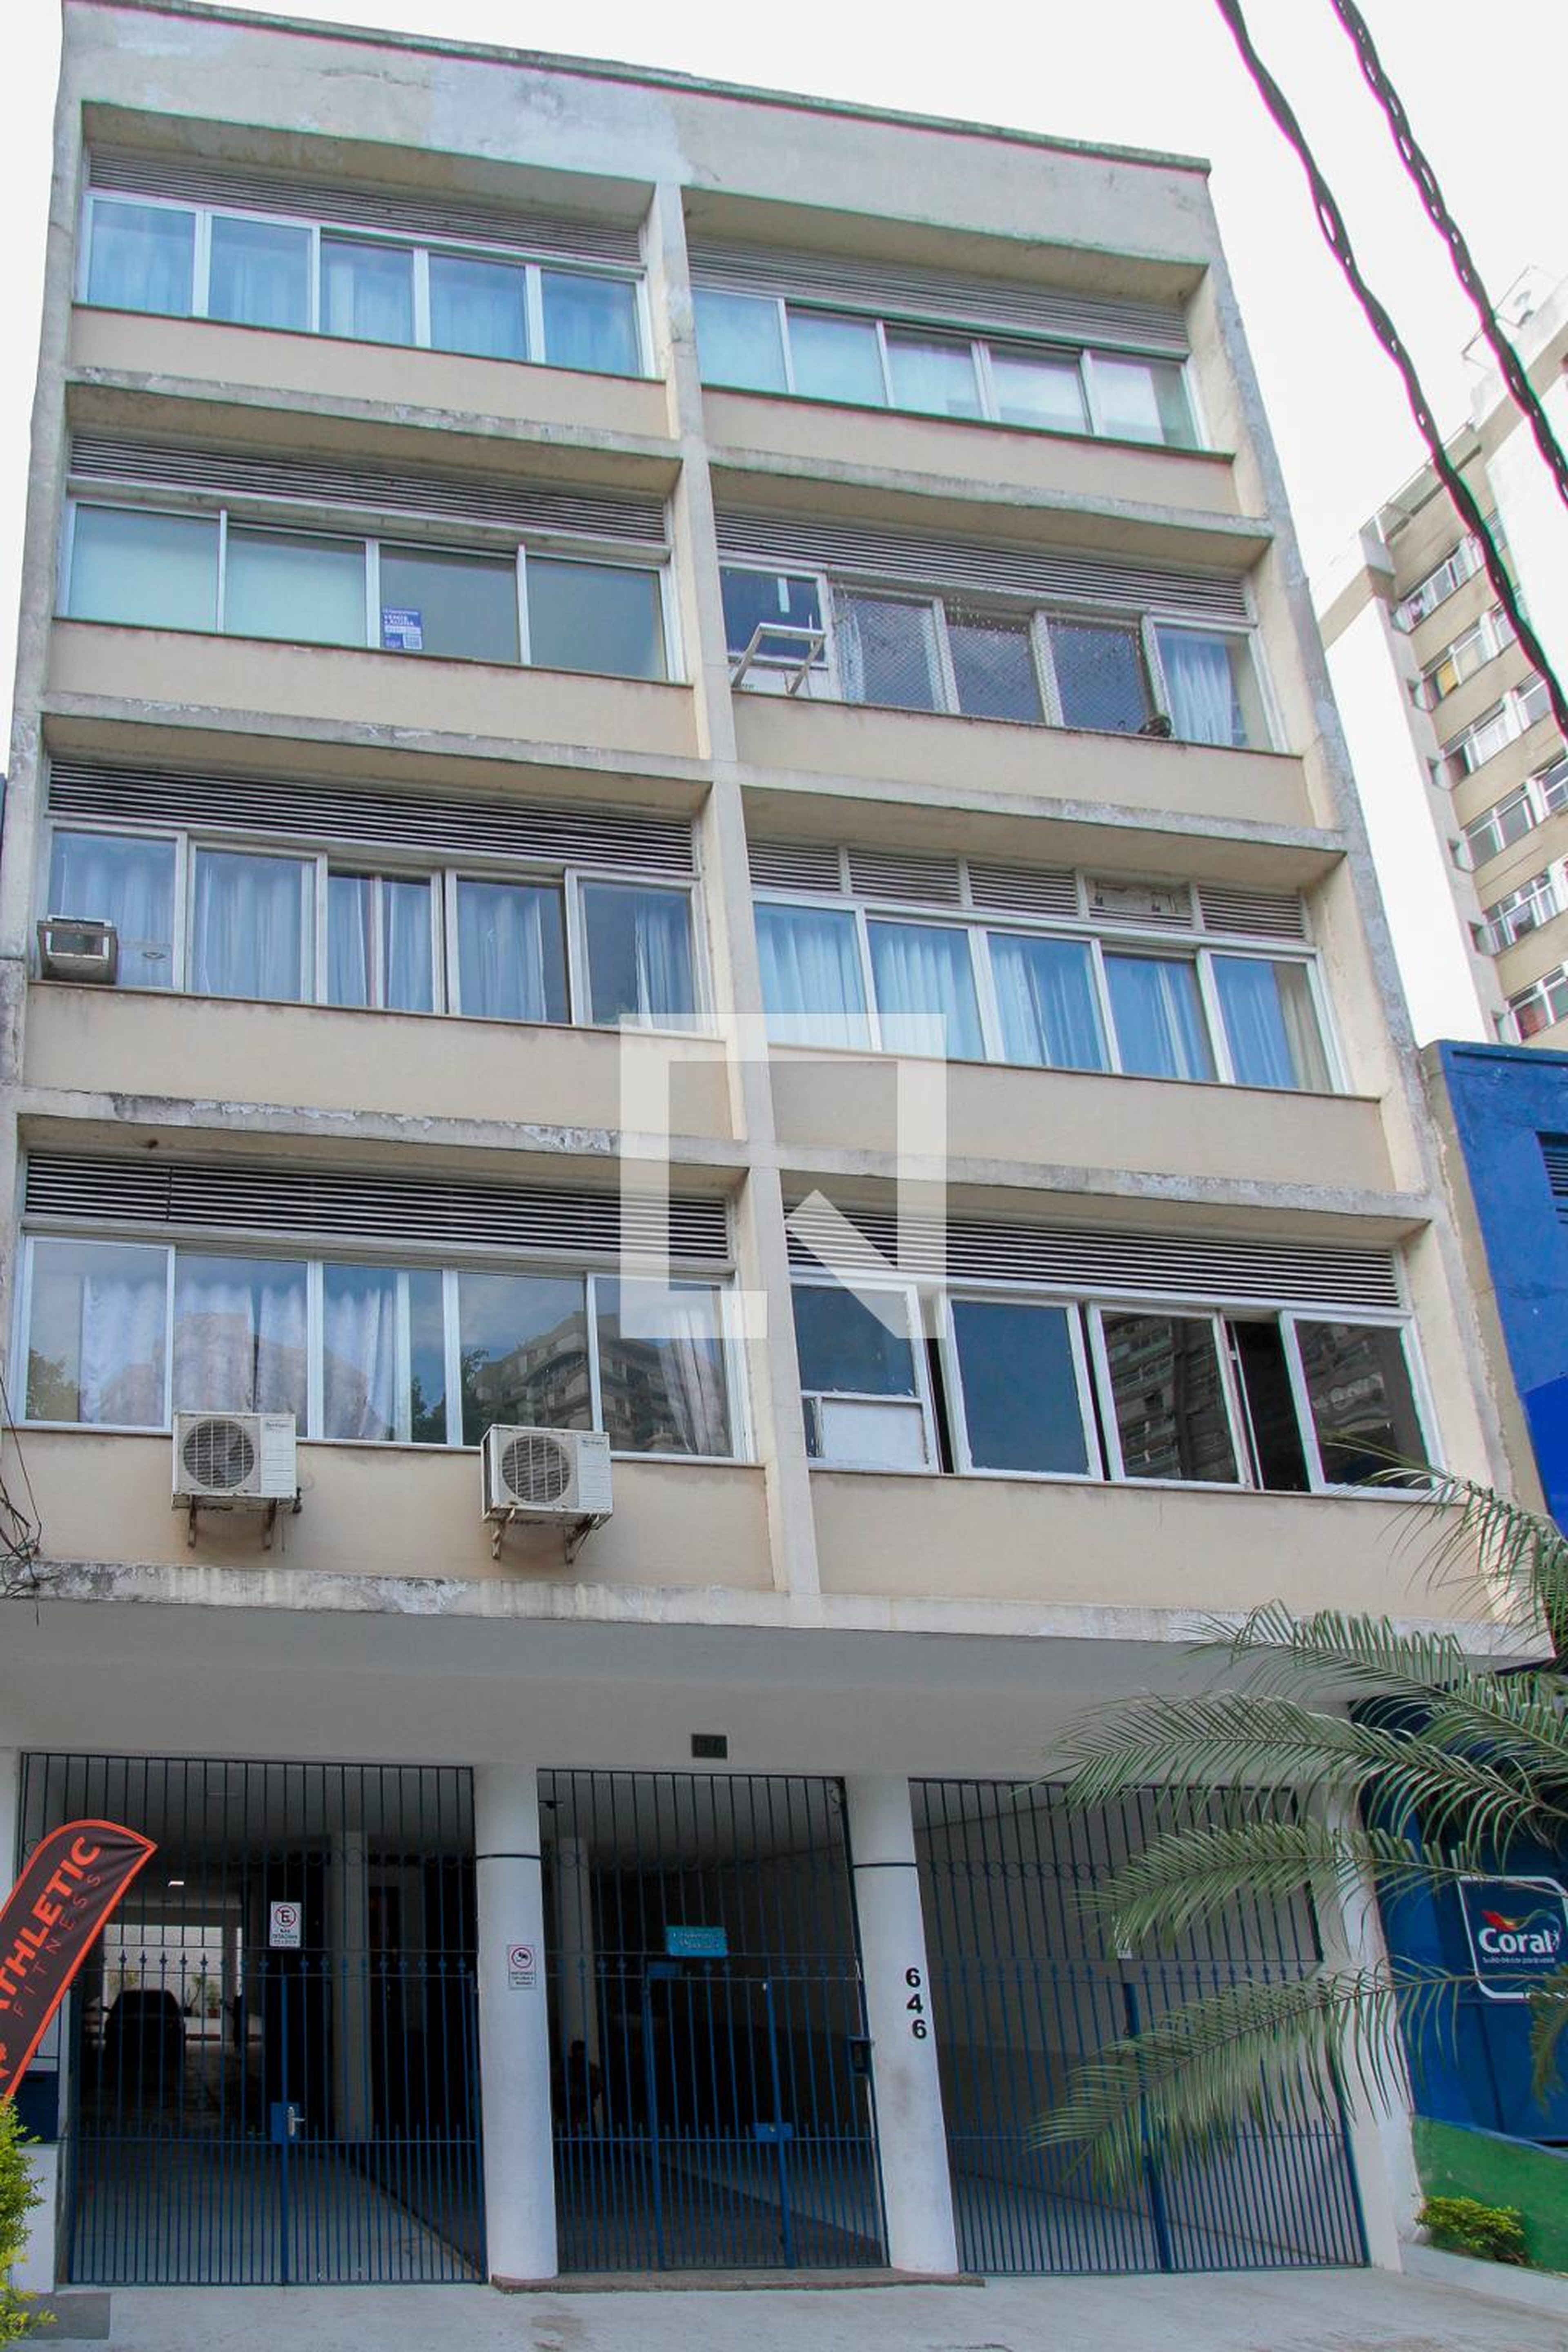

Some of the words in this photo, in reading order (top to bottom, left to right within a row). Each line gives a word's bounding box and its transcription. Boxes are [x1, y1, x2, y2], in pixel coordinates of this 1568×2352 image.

[13, 1873, 102, 2018] FITNESS
[1479, 1927, 1554, 1953] Coral
[905, 1967, 927, 2040] 646
